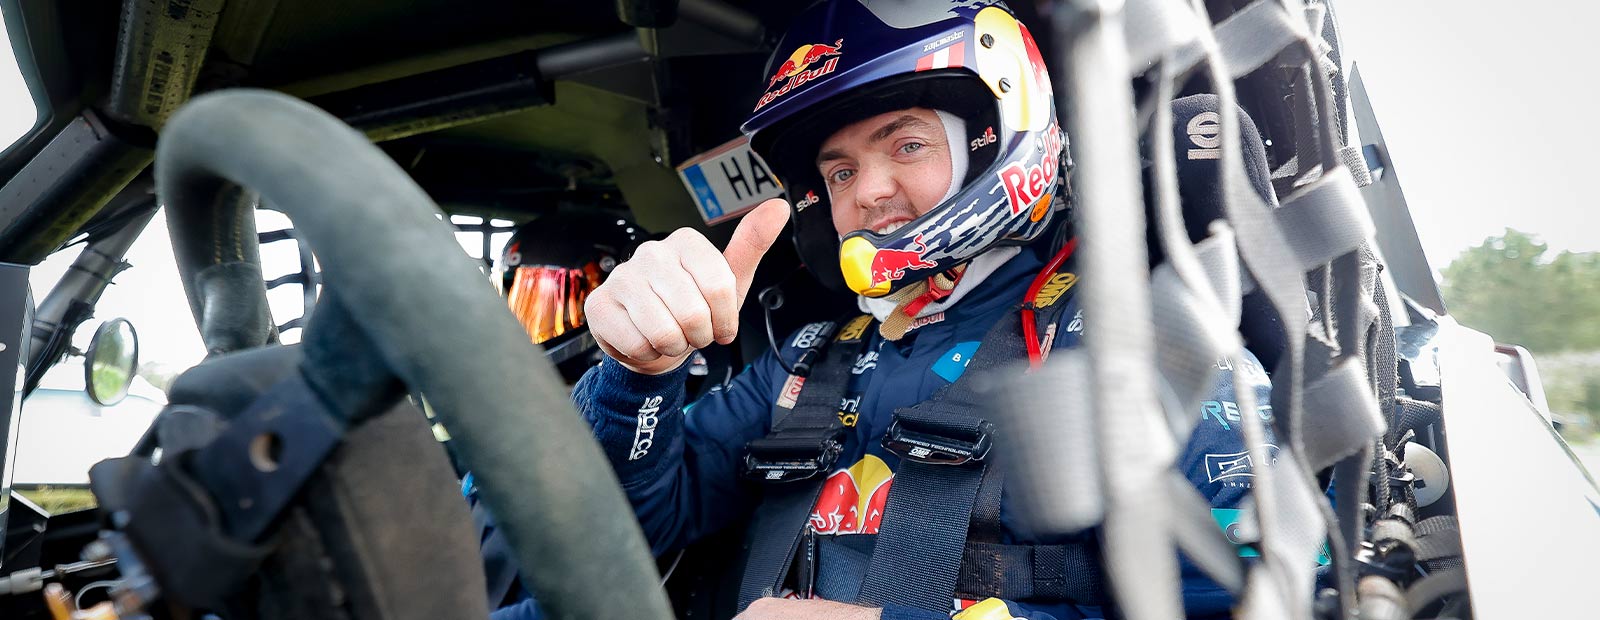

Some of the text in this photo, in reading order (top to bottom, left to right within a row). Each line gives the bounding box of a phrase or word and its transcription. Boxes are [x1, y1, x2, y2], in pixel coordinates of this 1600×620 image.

[753, 56, 840, 113] Red Bull
[720, 149, 778, 201] HA
[998, 131, 1055, 218] Red
[628, 395, 664, 461] sparco
[908, 446, 932, 459] OMP
